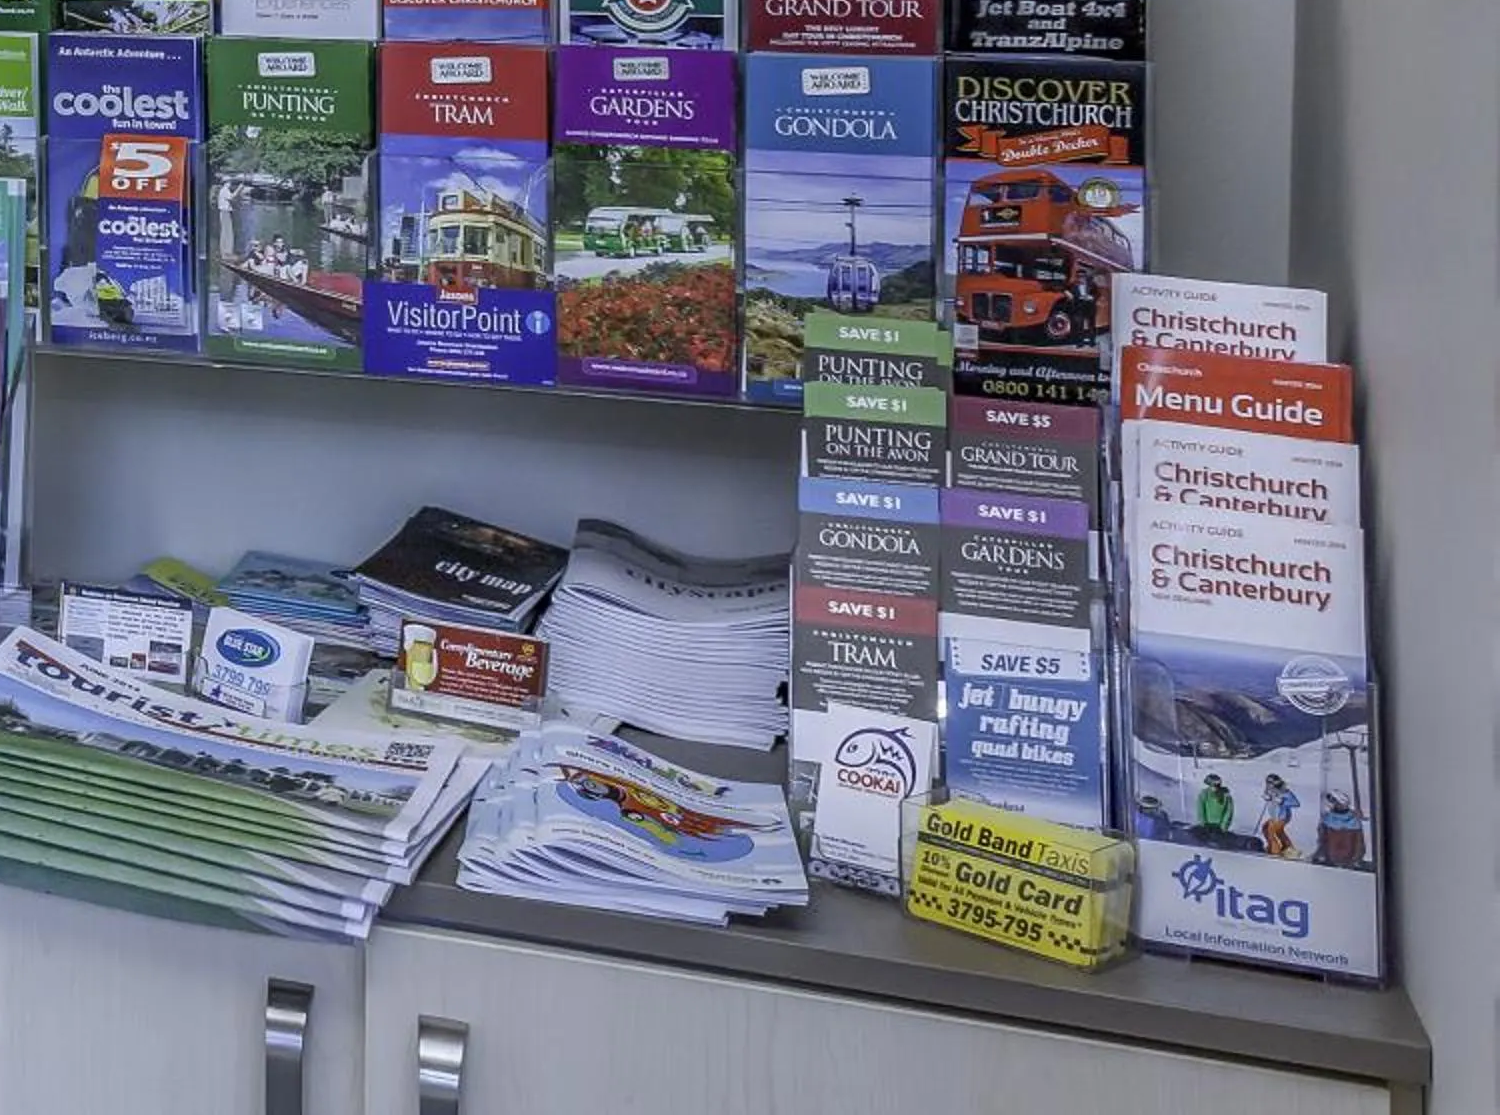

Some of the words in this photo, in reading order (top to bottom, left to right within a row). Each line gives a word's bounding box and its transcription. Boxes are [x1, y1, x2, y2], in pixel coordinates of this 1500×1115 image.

[1027, 18, 1065, 31] and
[53, 85, 190, 119] coolest
[243, 92, 335, 114] PUNTING
[958, 76, 1132, 104] DISCOVER
[432, 103, 494, 126] TRAM
[590, 97, 694, 120] GARDENS
[955, 99, 1133, 129] CHRISTCHURCH
[775, 116, 898, 140] GONDOLA
[111, 178, 168, 192] OFF
[387, 300, 521, 334] VisitorPoint
[1131, 307, 1297, 342] Christchurch
[838, 326, 880, 340] SAVE
[883, 328, 899, 343] $1
[846, 395, 888, 411] SAVE
[891, 397, 907, 412] $1
[1135, 384, 1222, 414] Menu
[1231, 395, 1323, 426] Guide
[986, 410, 1029, 426] SAVE
[1032, 415, 1051, 428] $5
[825, 424, 932, 449] PUNTING
[826, 443, 850, 456] ON
[853, 444, 885, 459] THE
[888, 447, 930, 463] AVON
[1154, 461, 1328, 501] Christchurch
[434, 558, 479, 583] city
[480, 571, 533, 595] map
[1151, 543, 1331, 584] Christchurch
[1152, 569, 1171, 588] &
[1178, 572, 1331, 612] Canterbury
[465, 651, 536, 680] Beverage
[980, 653, 1028, 674] SAVE
[1032, 655, 1061, 675] $5
[925, 813, 974, 842] Gold
[976, 828, 1034, 860] Band
[1035, 842, 1090, 875] Taxis
[954, 860, 1014, 896] Gold
[1018, 880, 1084, 916] Card
[947, 896, 1043, 943] 3795-795
[1215, 884, 1310, 938] itag
[1165, 925, 1200, 940] Local
[1203, 932, 1285, 954] Information
[1288, 947, 1349, 966] Network
